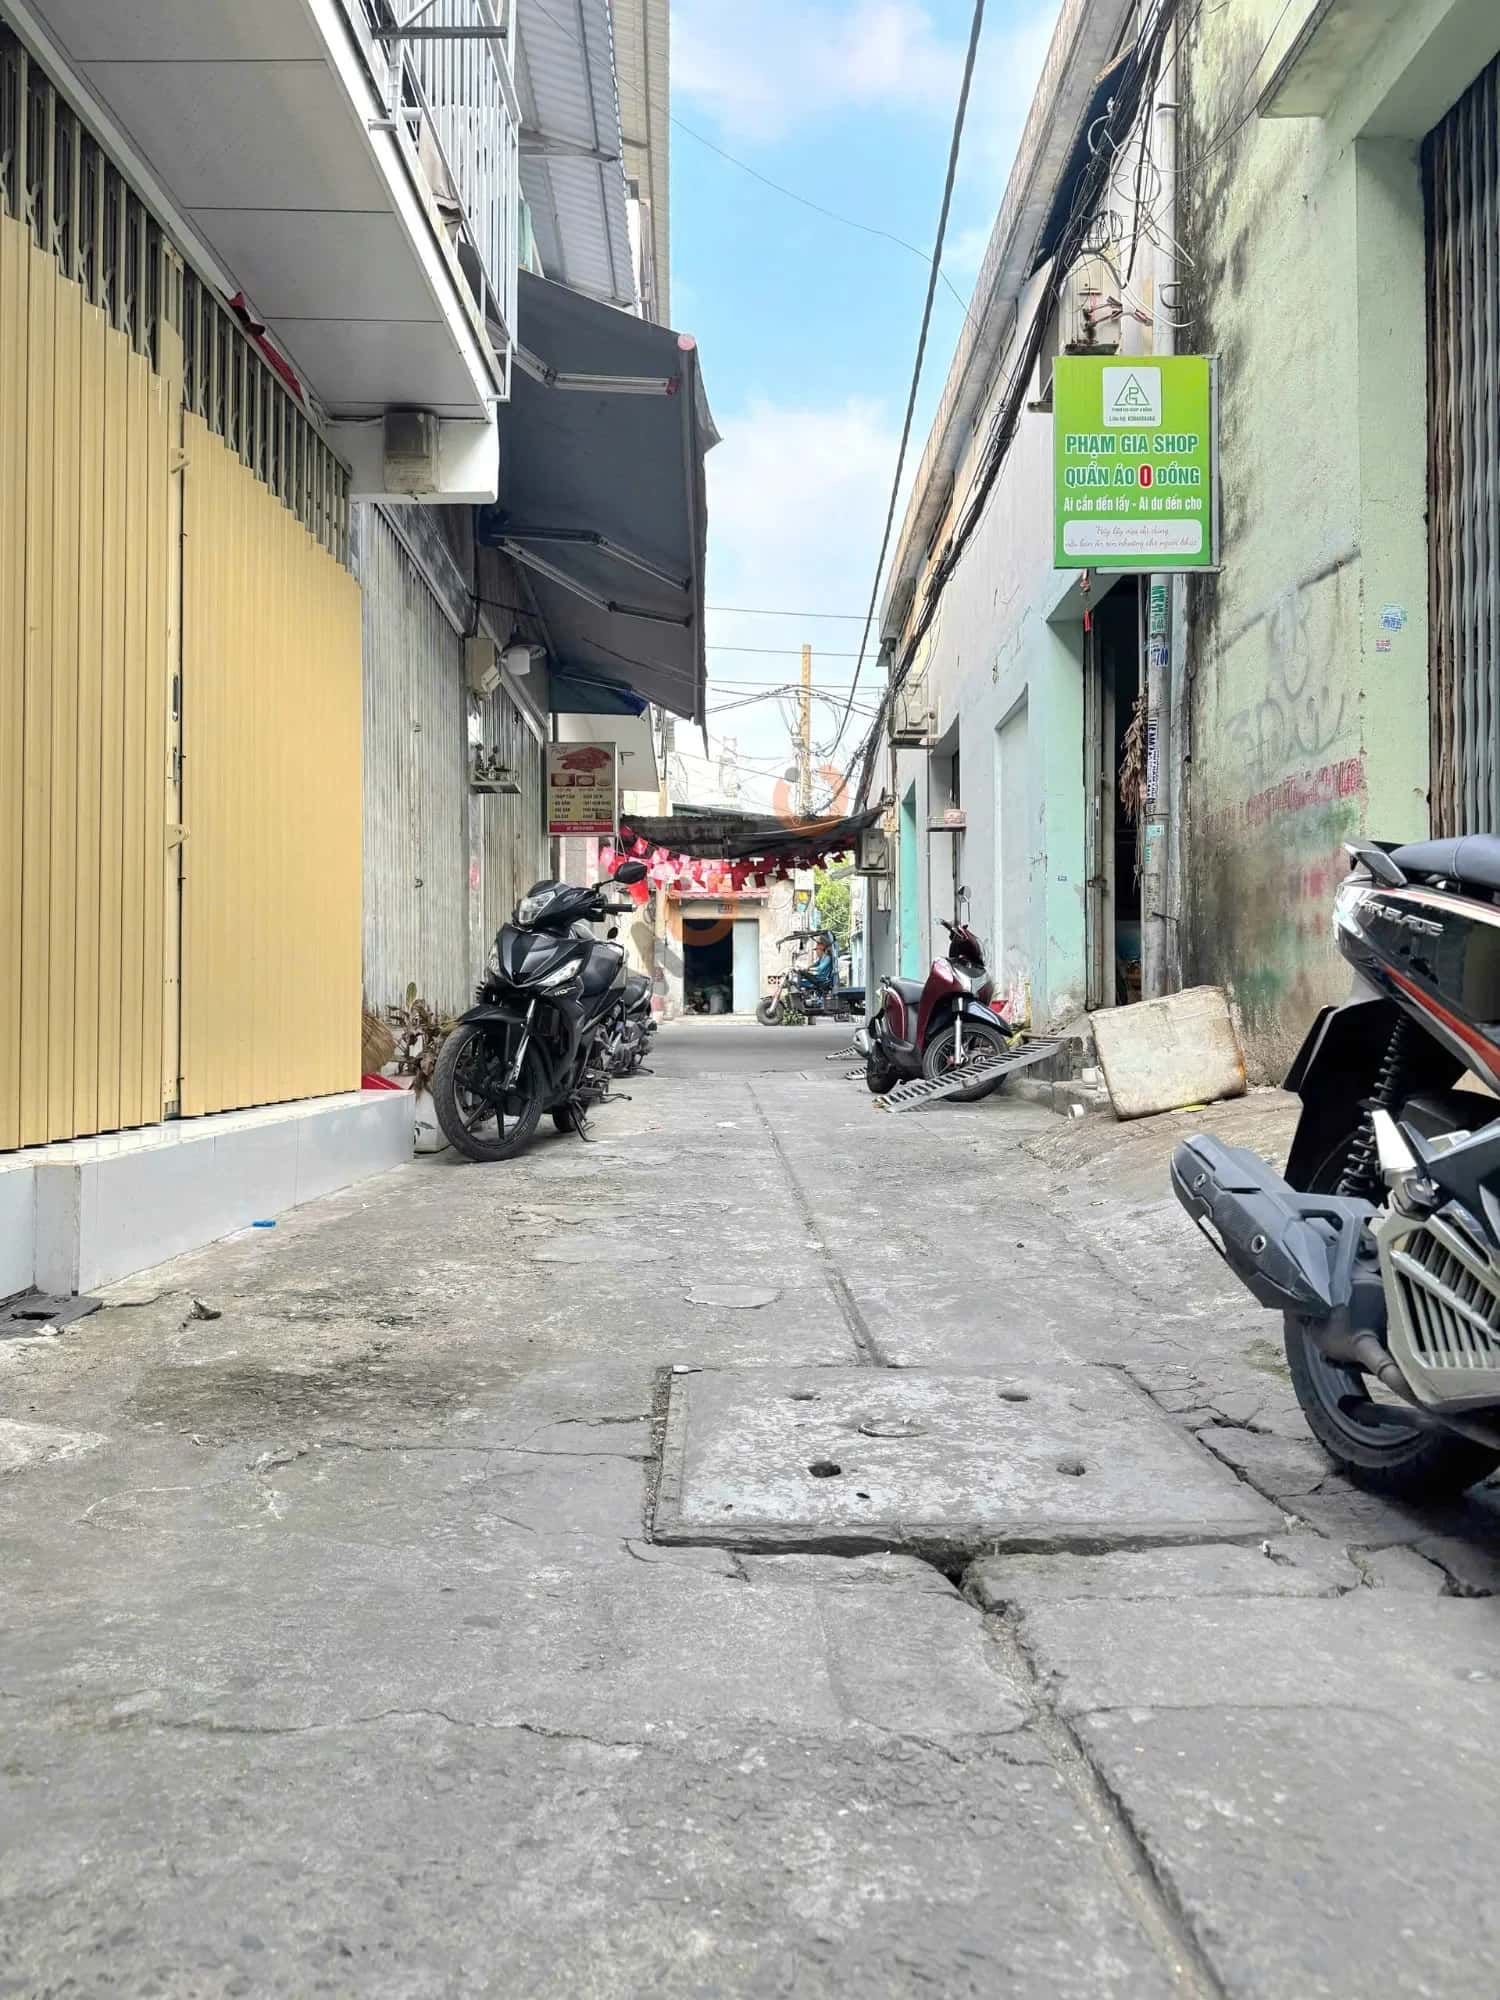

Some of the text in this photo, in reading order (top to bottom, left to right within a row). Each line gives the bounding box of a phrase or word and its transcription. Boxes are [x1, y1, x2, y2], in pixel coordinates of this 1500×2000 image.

[1065, 433, 1199, 458] PHẠM GIA SHOP
[1113, 463, 1136, 487] ÁO
[1138, 464, 1153, 488] 0
[1063, 496, 1074, 512] Ai
[1139, 496, 1148, 512] Ai
[1184, 495, 1203, 511] cho
